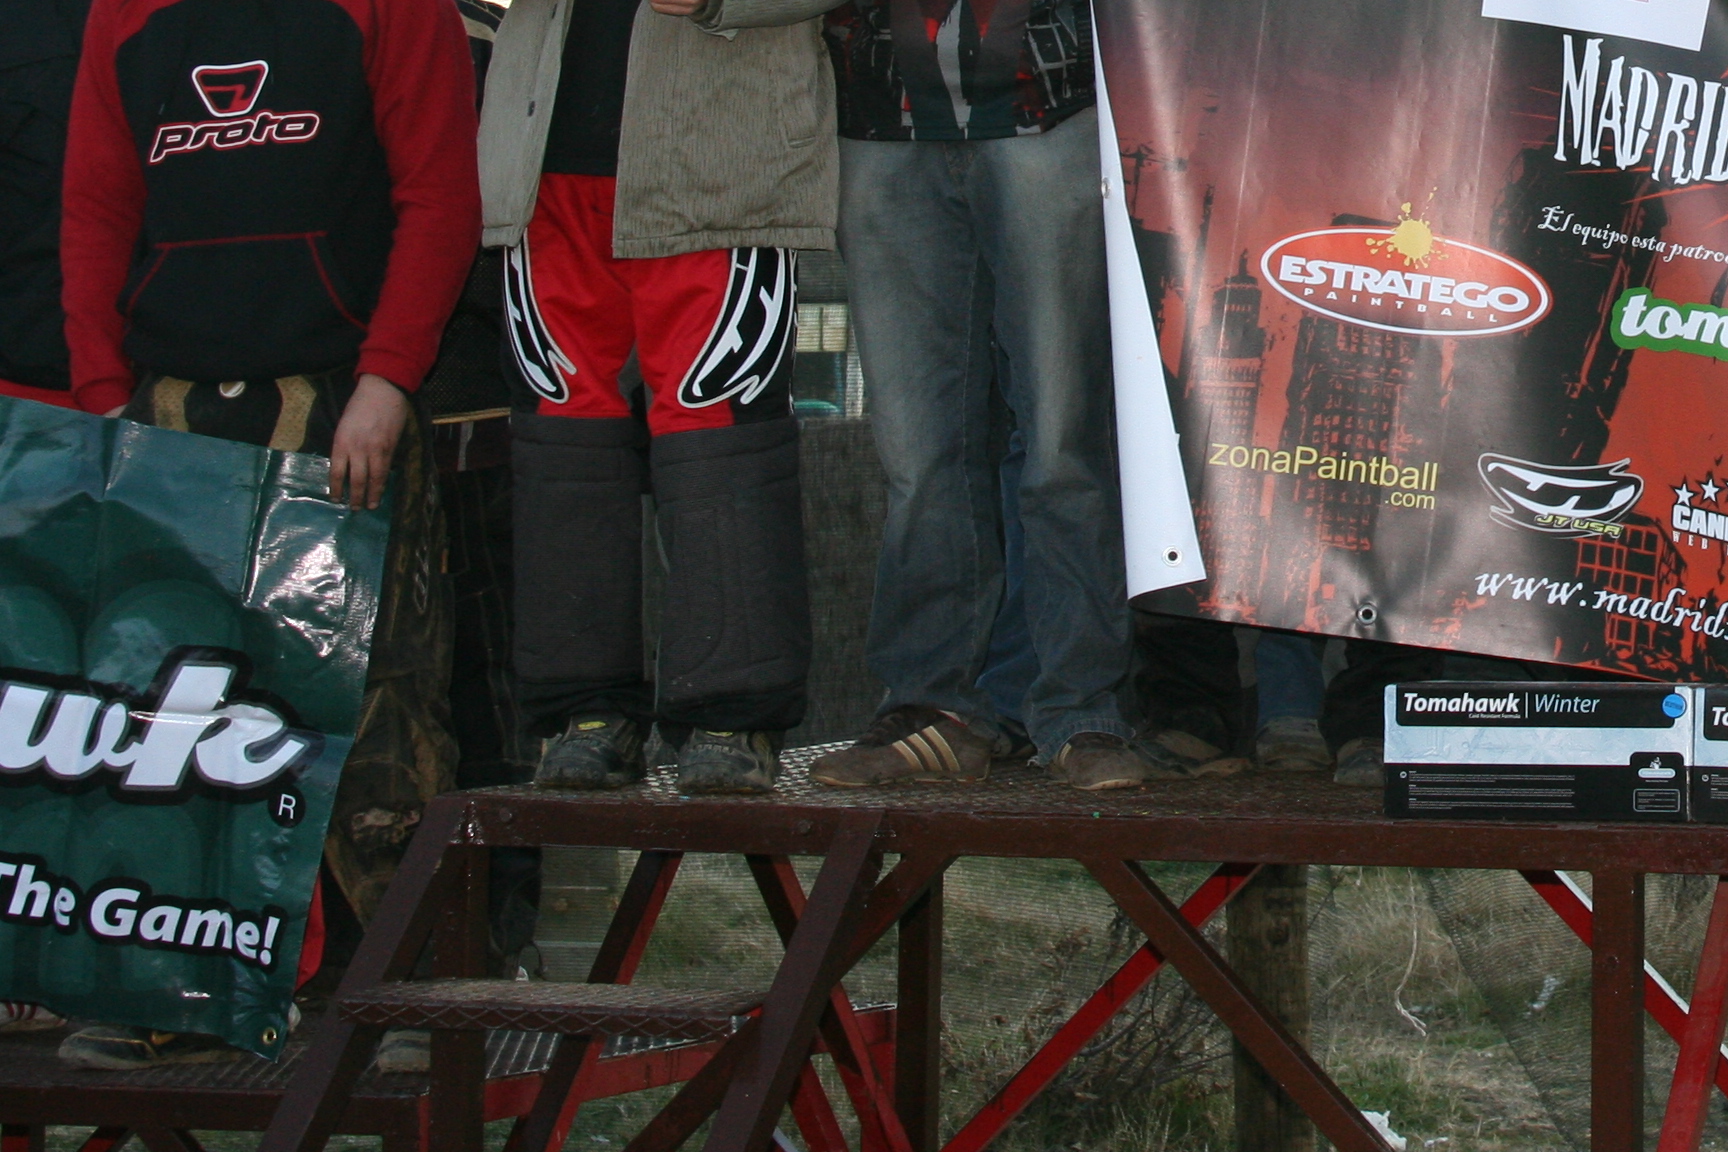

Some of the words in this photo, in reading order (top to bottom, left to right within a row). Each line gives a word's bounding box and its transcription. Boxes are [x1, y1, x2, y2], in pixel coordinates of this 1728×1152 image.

[149, 111, 322, 164] proto
[1537, 205, 1570, 232] El
[1572, 222, 1629, 247] equipo
[1631, 234, 1665, 252] esta
[1279, 255, 1530, 313] ESTRATEGO
[1303, 287, 1498, 323] PAINTBALL
[1208, 442, 1439, 492] zonaPaintball
[1384, 491, 1436, 510] .com
[1403, 692, 1520, 714] Tomahawk
[1535, 693, 1600, 714] Winter
[90, 887, 281, 966] Game!
